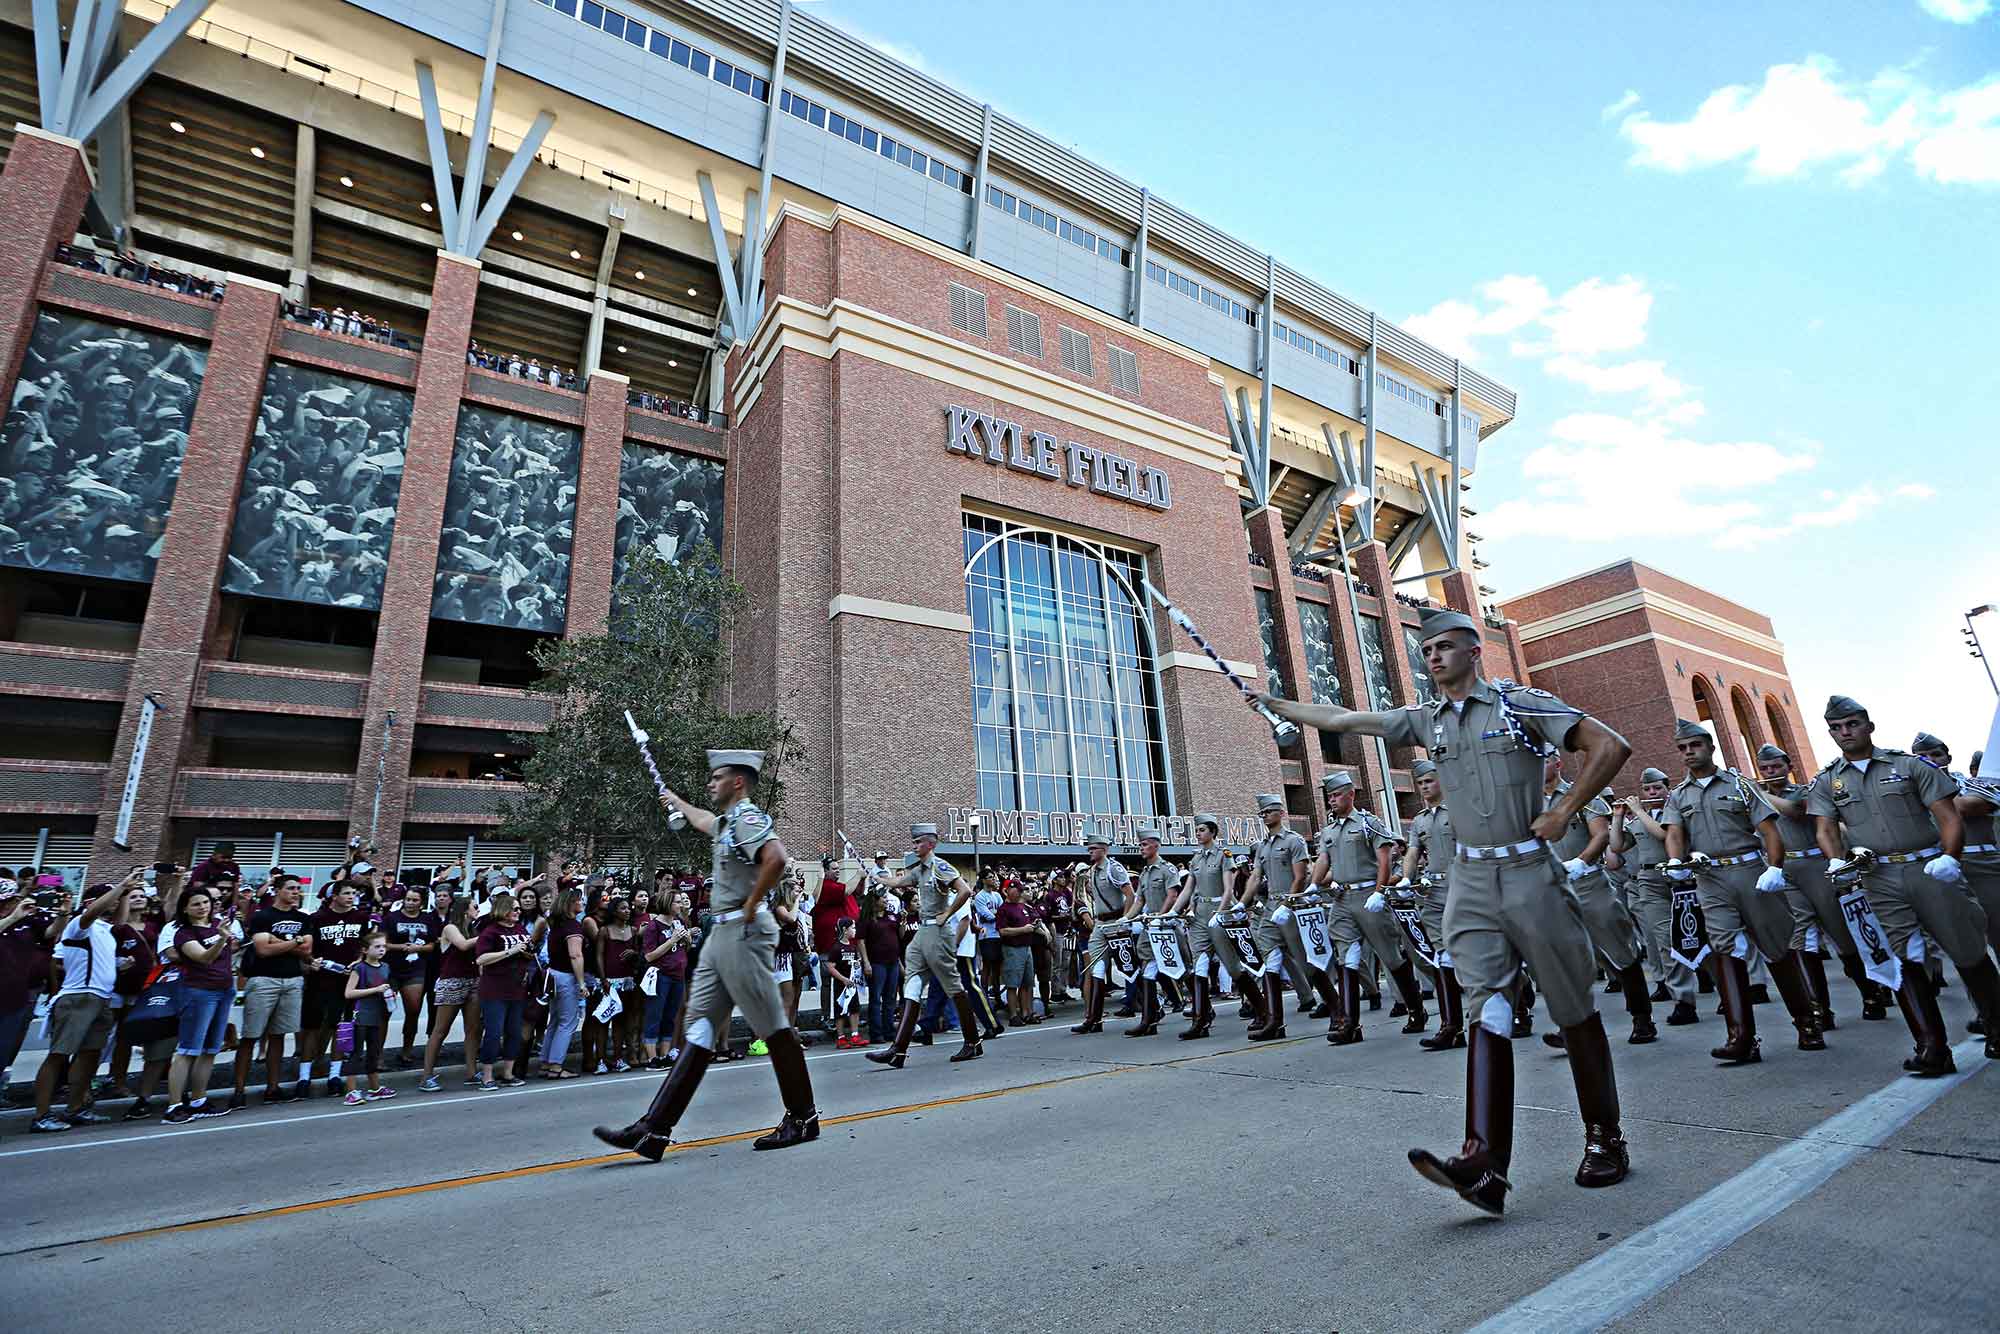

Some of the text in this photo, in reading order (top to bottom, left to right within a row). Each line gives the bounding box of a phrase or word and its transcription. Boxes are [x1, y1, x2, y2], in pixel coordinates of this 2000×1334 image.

[945, 404, 1172, 511] KYLE FIELD
[948, 808, 1041, 843] HOME
[1050, 812, 1087, 844] OF
[1159, 815, 1219, 846] 12T
[320, 930, 360, 941] AGGIES
